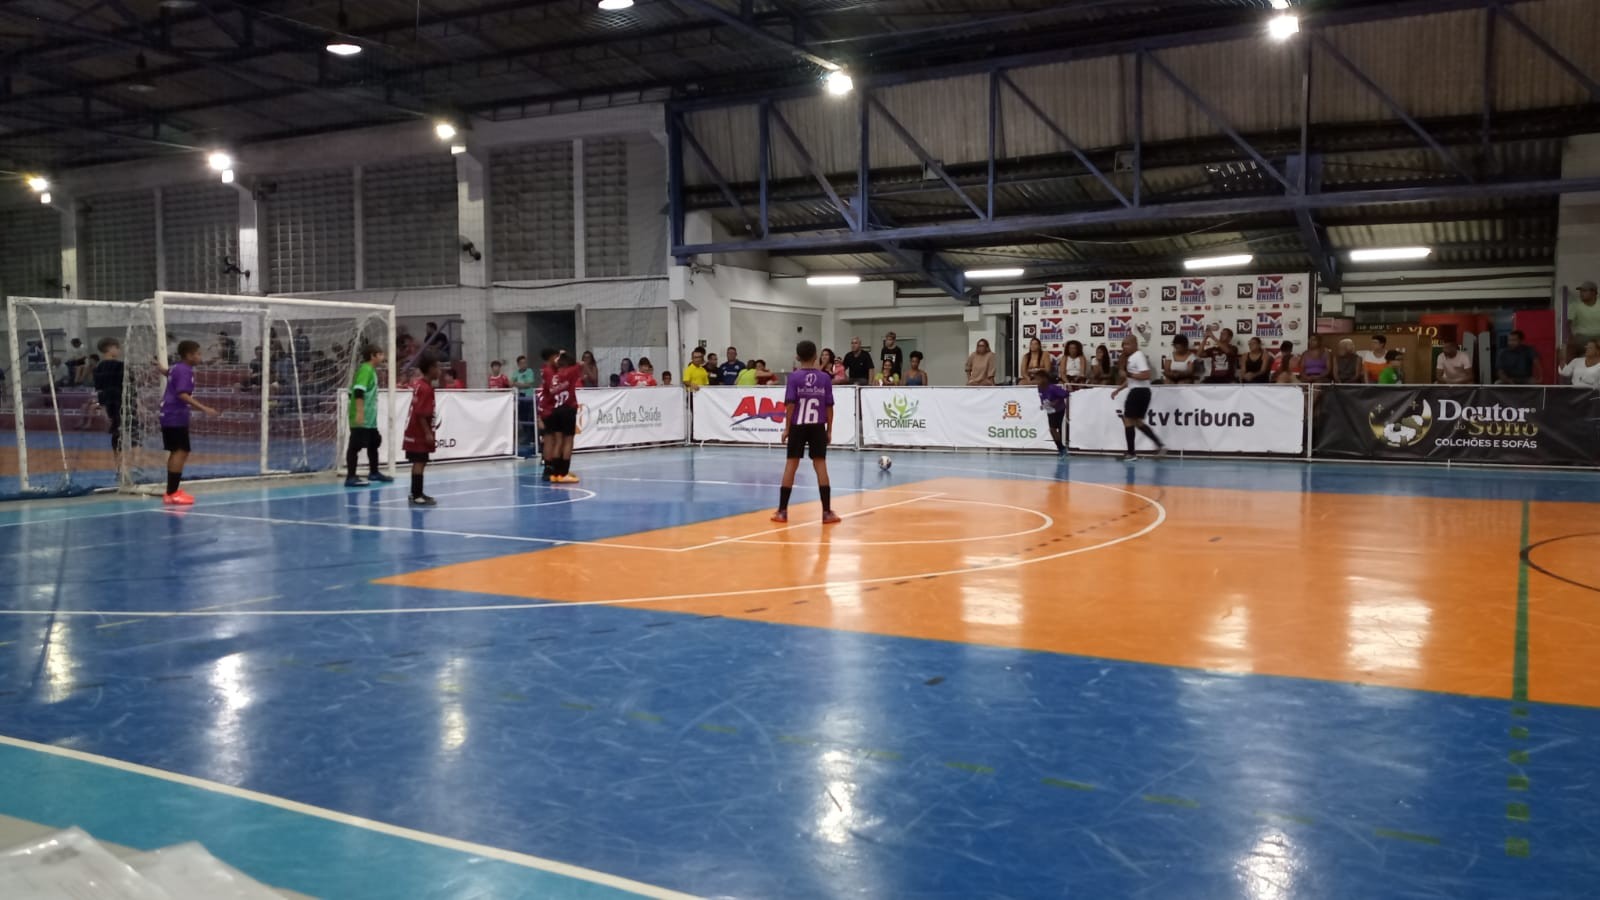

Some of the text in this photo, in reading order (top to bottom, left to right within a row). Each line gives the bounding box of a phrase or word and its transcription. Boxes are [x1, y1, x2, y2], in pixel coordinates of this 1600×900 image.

[596, 405, 662, 424] Ana Costa Saúde
[797, 398, 820, 425] 16
[1147, 408, 1255, 427] tv tribuna
[1437, 399, 1530, 422] Doutor
[876, 418, 927, 429] PROMIFAE
[988, 426, 1037, 439] Santos
[434, 438, 457, 448] ORLD
[1434, 437, 1538, 449] COLCHÕES E SOFÁS
